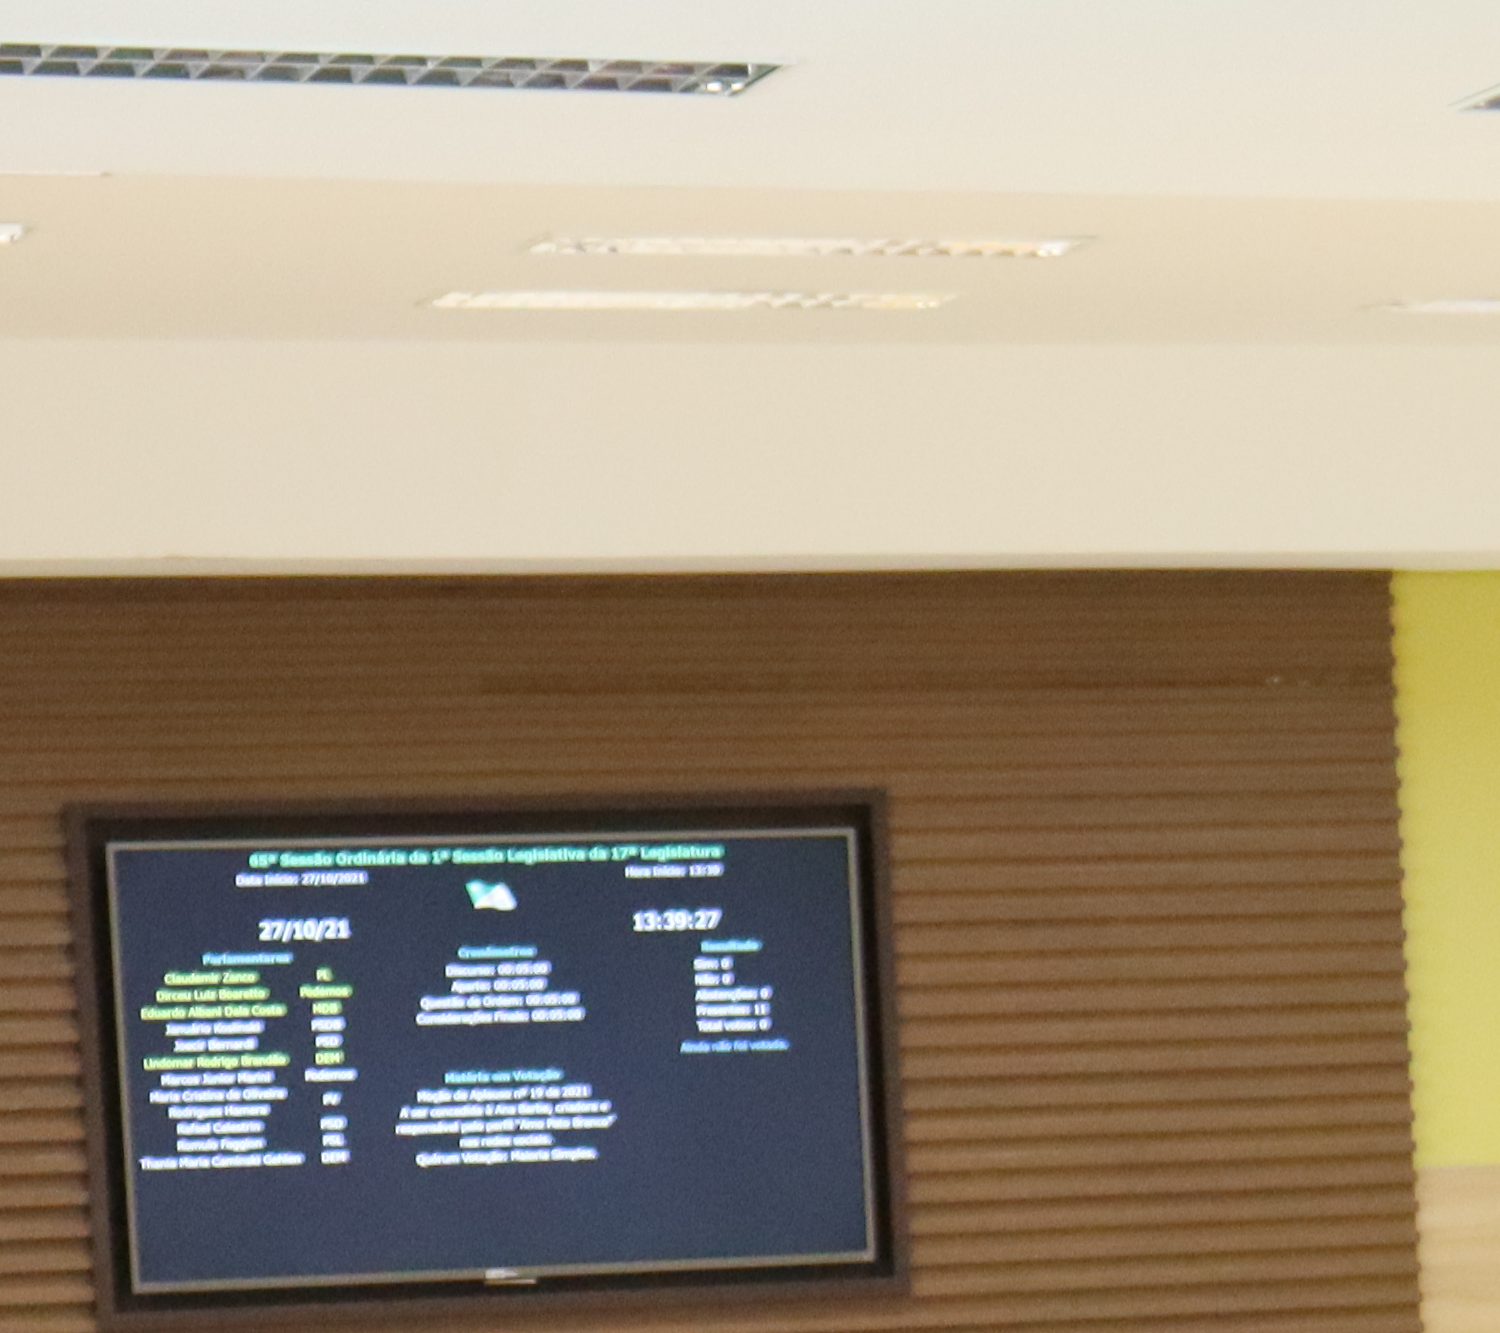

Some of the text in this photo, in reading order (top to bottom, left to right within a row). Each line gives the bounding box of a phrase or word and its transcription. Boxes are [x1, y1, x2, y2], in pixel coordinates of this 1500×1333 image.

[280, 852, 333, 867] Sessão
[335, 851, 408, 866] Ordinária
[409, 850, 431, 864] da
[452, 849, 506, 863] Sessão
[507, 847, 586, 864] Legislativa
[588, 846, 610, 861] da
[640, 845, 724, 861] Legislatura
[259, 919, 350, 941] 27/10/21
[633, 909, 721, 931] 13:39:27
[141, 1006, 187, 1020] Eduardo
[250, 1004, 287, 1016] Costa
